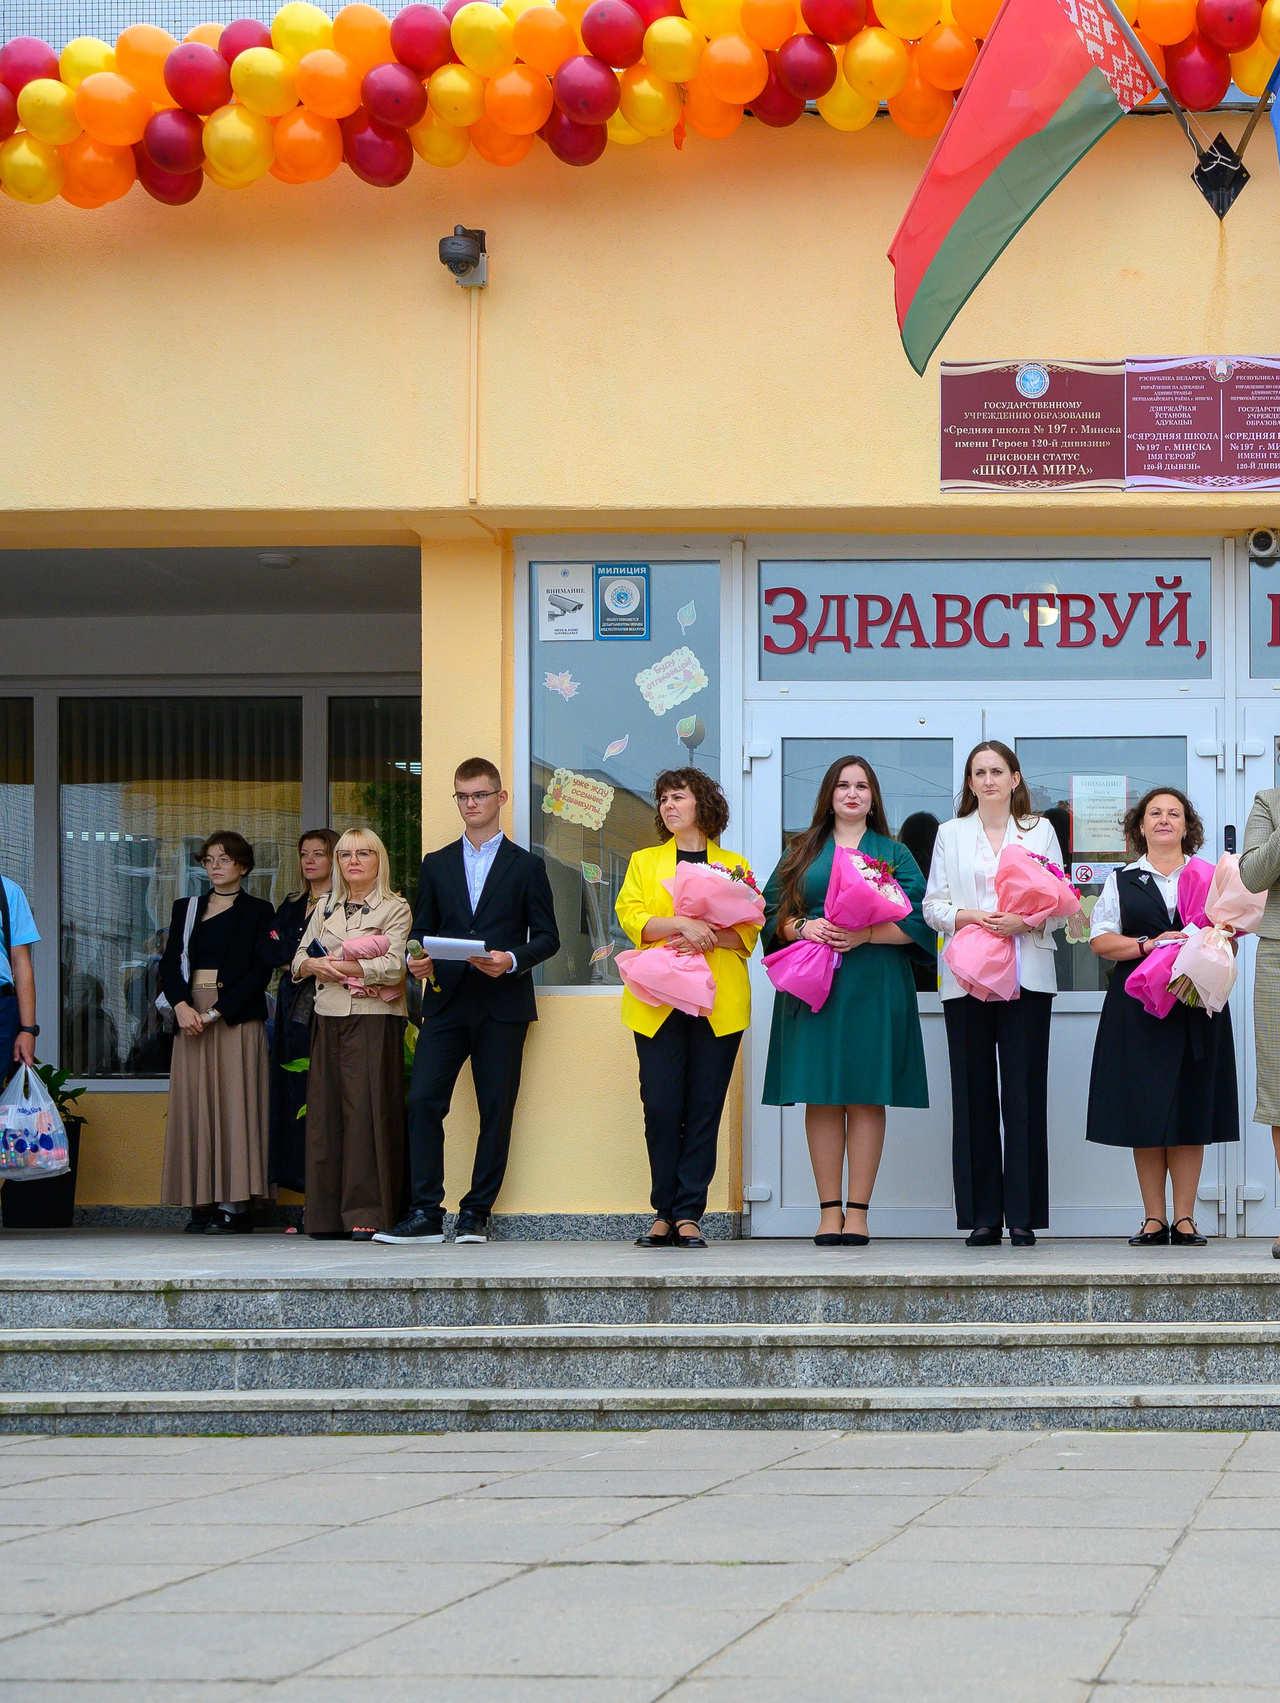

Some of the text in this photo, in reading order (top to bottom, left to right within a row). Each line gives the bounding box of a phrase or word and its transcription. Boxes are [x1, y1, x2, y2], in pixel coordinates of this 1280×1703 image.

[984, 401, 1082, 409] ГОСУДАРСТВЕННОМУ
[964, 412, 1101, 420] УЧРЕЖДЕНИЮ ОБРАЗОВАНИЯ
[944, 425, 993, 435] «Средняя
[1034, 425, 1044, 434] №
[1048, 424, 1068, 434] 197
[1080, 425, 1122, 434] Минска
[1224, 432, 1275, 440] «СРЕДНЯЯ
[992, 439, 1028, 449] Героев
[1032, 439, 1058, 448] 120-й
[1060, 440, 1111, 449] дивизии»
[972, 465, 1093, 476] «ШКОЛА МИРА»
[653, 659, 675, 674] Буду
[571, 788, 604, 804] осенние
[591, 785, 609, 798] жду
